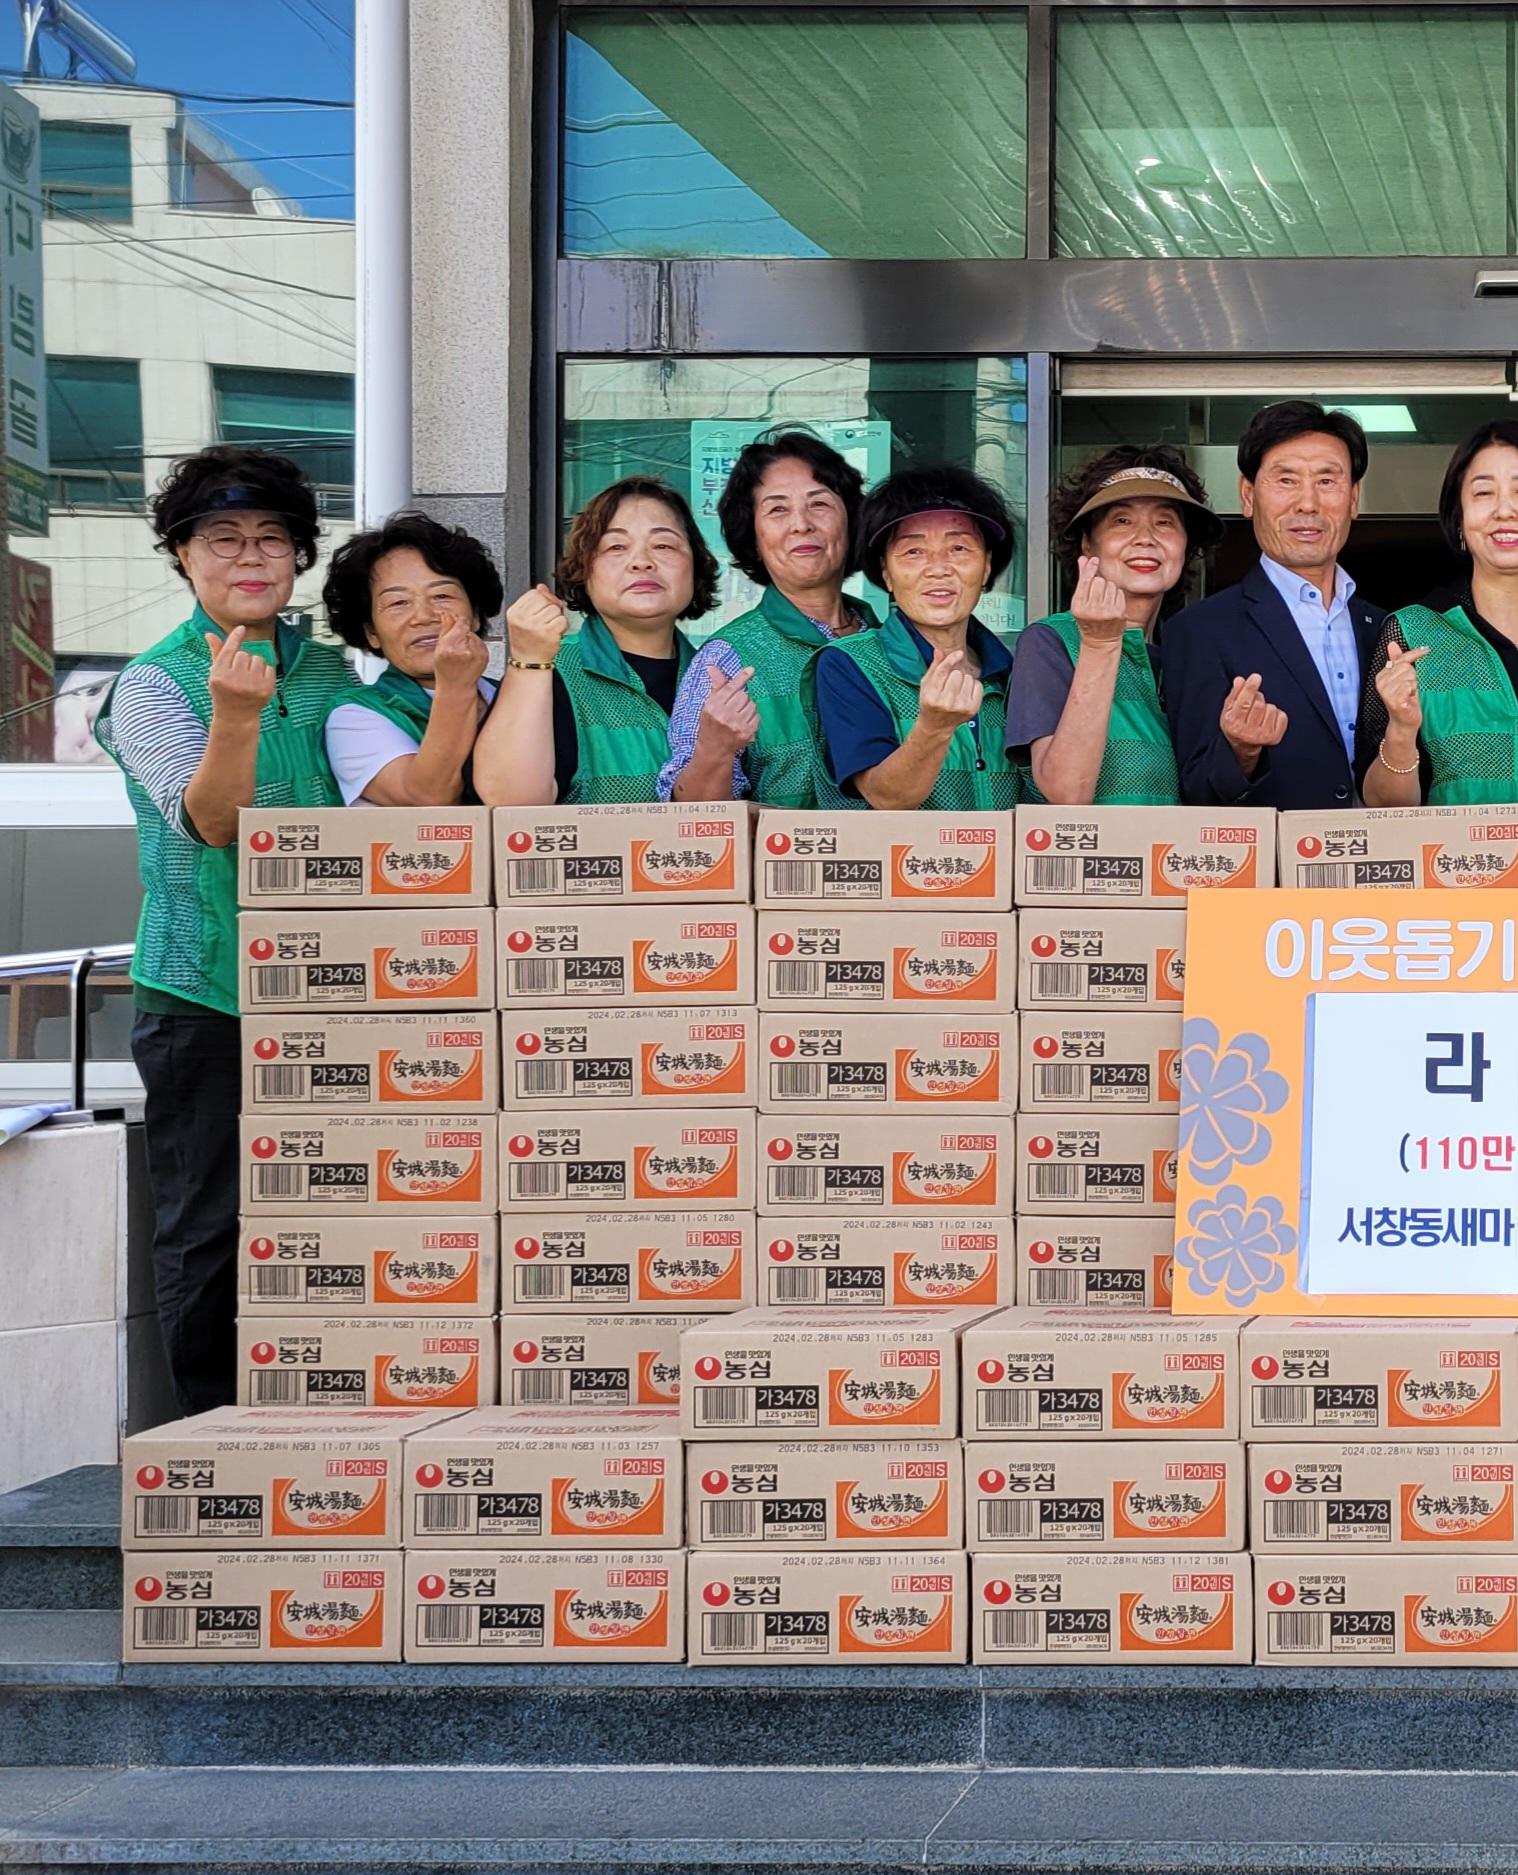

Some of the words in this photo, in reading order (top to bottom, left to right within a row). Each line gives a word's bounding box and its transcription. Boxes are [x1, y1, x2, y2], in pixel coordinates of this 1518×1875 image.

[278, 835, 318, 851] 농심
[536, 836, 577, 852] 농심
[795, 838, 836, 854] 농심
[1056, 833, 1097, 850] 농심
[1326, 840, 1367, 857] 농심
[278, 943, 320, 959] 농심
[536, 935, 577, 952] 농심
[798, 938, 839, 954] 농심
[1060, 940, 1102, 957] 농심
[1265, 917, 1515, 982] 이웃돕기
[282, 1042, 324, 1058] 농심
[545, 1038, 586, 1053] 농심
[799, 1039, 841, 1056] 농심
[1062, 1041, 1104, 1058] 농심
[280, 1141, 323, 1157] 농심
[538, 1139, 580, 1156] 농심
[797, 1143, 838, 1160] 농심
[1057, 1141, 1099, 1157] 농심
[278, 1242, 319, 1259] 농심
[543, 1242, 584, 1258] 농심
[798, 1244, 839, 1260] 농심
[1058, 1246, 1099, 1263] 농심
[279, 1347, 321, 1364] 농심
[542, 1345, 584, 1362] 농심
[725, 1361, 770, 1379] 농심
[1008, 1364, 1053, 1382] 농심
[1283, 1360, 1328, 1378] 농심
[758, 1390, 817, 1406] 가3478
[1041, 1393, 1100, 1409] 가3478
[1316, 1389, 1376, 1406] 가3478
[167, 1471, 214, 1489] 농심
[447, 1469, 493, 1487] 농심
[732, 1474, 777, 1493] 농심
[1009, 1474, 1054, 1492] 농심
[1296, 1475, 1341, 1493] 농심
[201, 1500, 260, 1516] 가3478
[480, 1498, 539, 1514] 가3478
[765, 1503, 824, 1519] 가3478
[1042, 1503, 1101, 1519] 가3478
[1329, 1504, 1388, 1520] 가3478
[166, 1582, 211, 1600] 농심
[449, 1580, 495, 1598] 농심
[734, 1587, 780, 1606] 농심
[1015, 1584, 1061, 1603] 농심
[1299, 1586, 1345, 1605] 농심
[199, 1611, 258, 1627] 가3478
[482, 1609, 541, 1625] 가3478
[767, 1616, 826, 1632] 가3478
[1049, 1614, 1108, 1630] 가3478
[1333, 1616, 1392, 1632] 가3478
